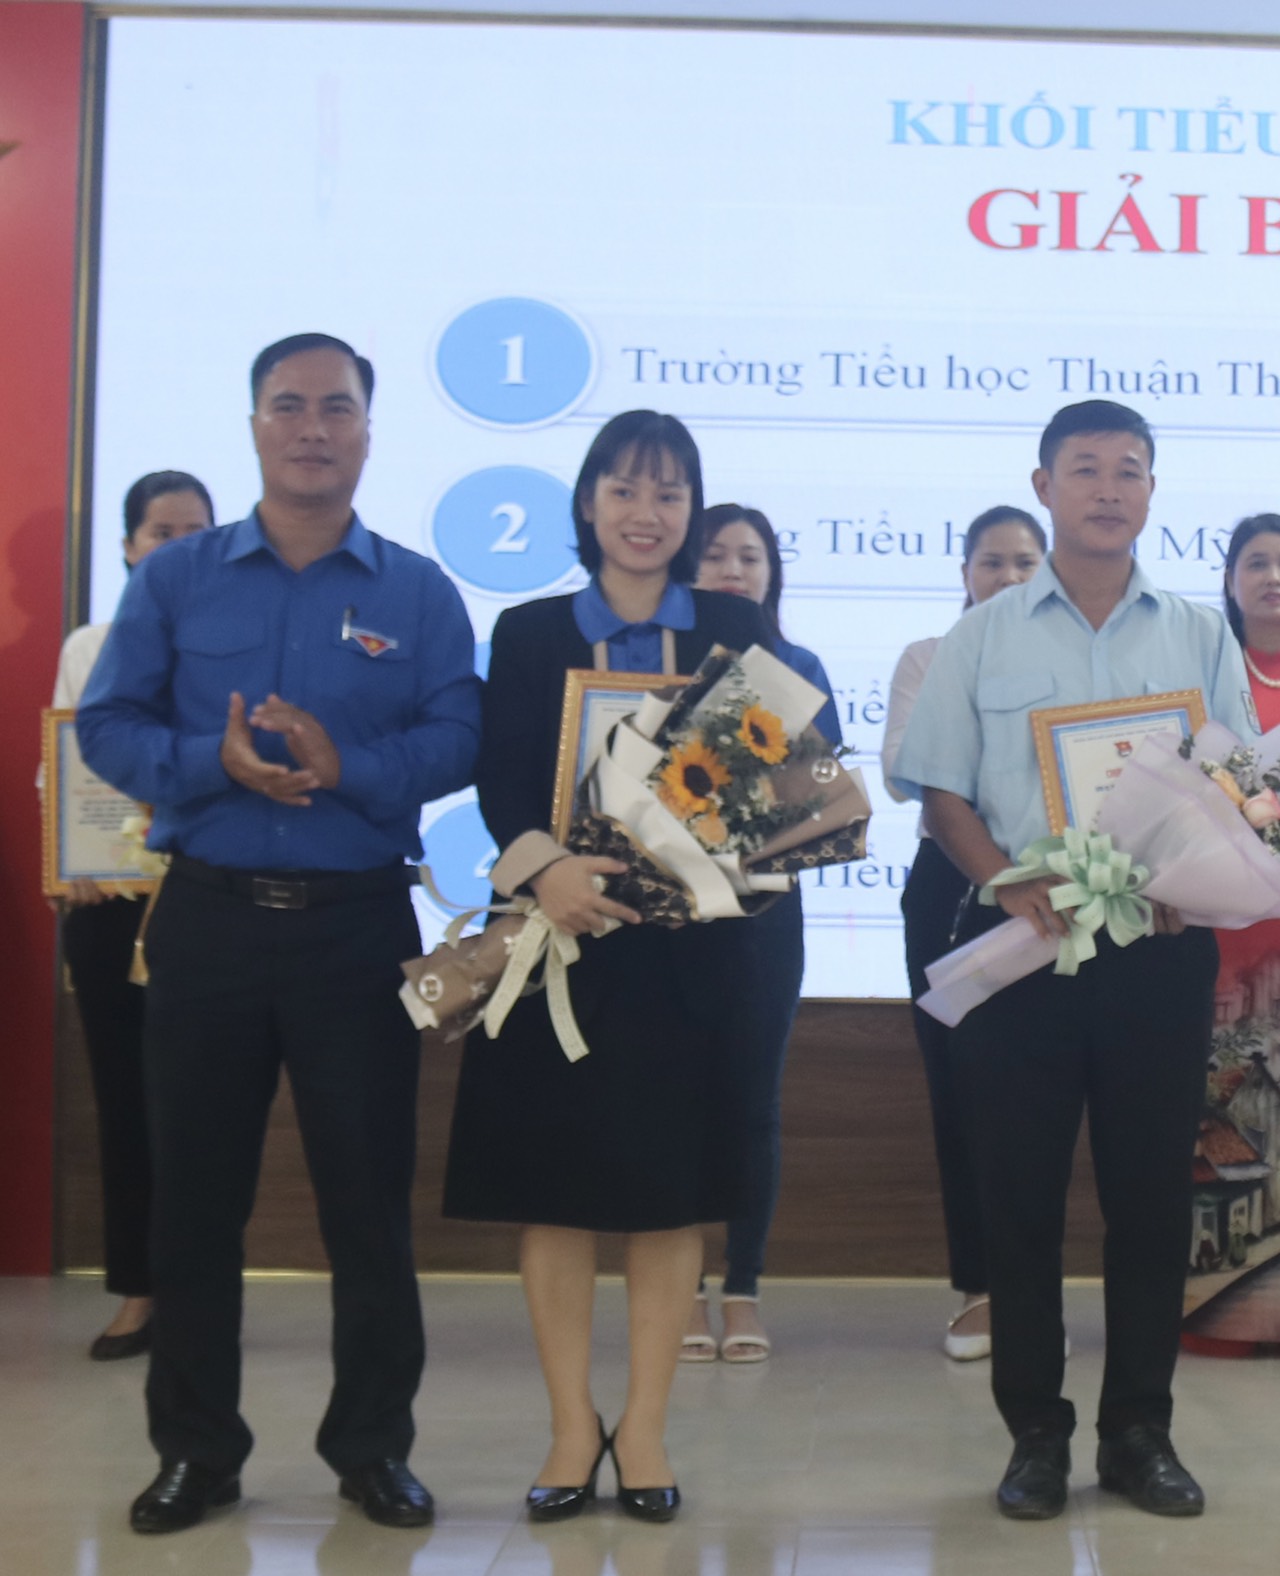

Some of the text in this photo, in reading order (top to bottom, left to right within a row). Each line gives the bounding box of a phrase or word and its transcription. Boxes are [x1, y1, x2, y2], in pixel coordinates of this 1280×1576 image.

[889, 90, 1095, 150] KHỐI
[966, 173, 1208, 255] GIẢI
[500, 335, 526, 386] 1
[621, 347, 803, 396] Trường
[820, 344, 927, 389] Tiểu
[946, 353, 1029, 398] học
[1049, 357, 1201, 400] Thuận
[488, 502, 530, 555] 2
[817, 510, 925, 556] Tiểu
